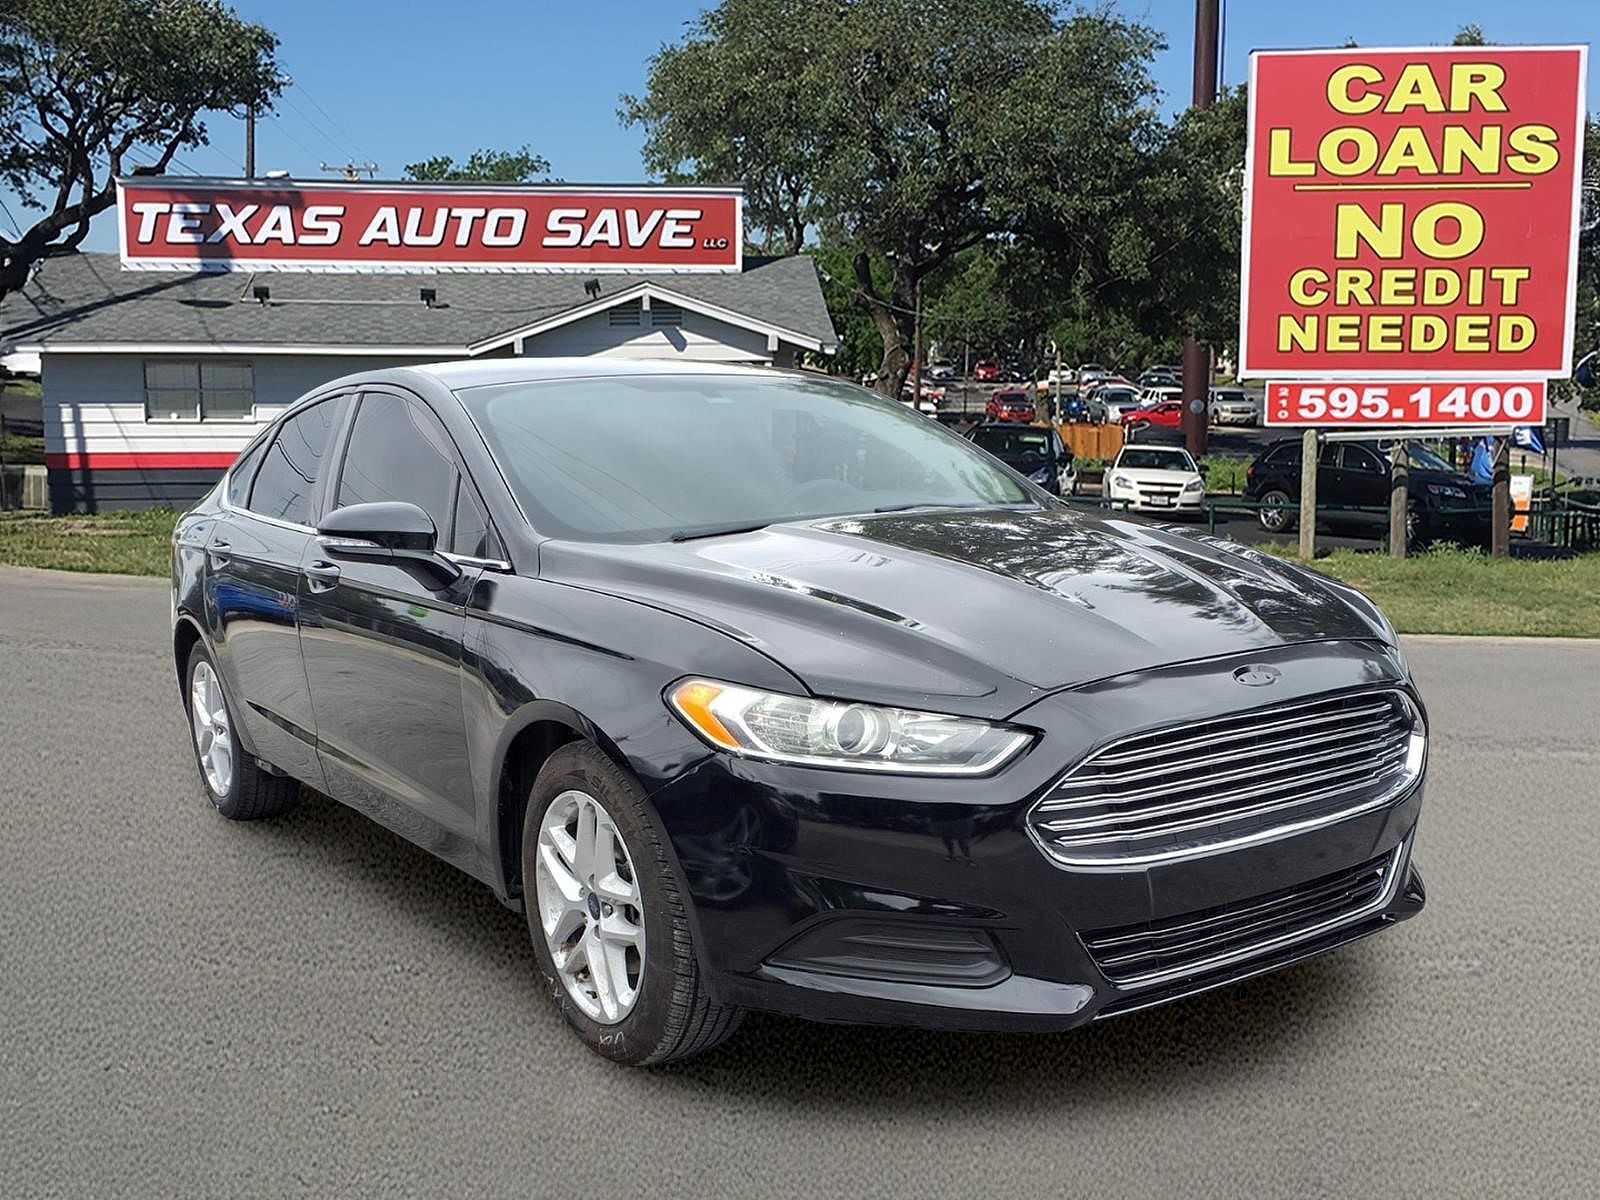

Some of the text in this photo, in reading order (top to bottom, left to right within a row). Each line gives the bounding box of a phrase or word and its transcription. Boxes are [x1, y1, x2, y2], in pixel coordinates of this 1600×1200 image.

[1326, 62, 1509, 114] CAR
[1268, 124, 1559, 177] LOANS
[132, 202, 728, 250] TEXAS AUTO SAVE LLC
[1335, 201, 1486, 260] NO
[1288, 267, 1531, 306] CREDIT
[1277, 314, 1537, 353] NEEDED
[1297, 387, 1533, 420] 595.1400
